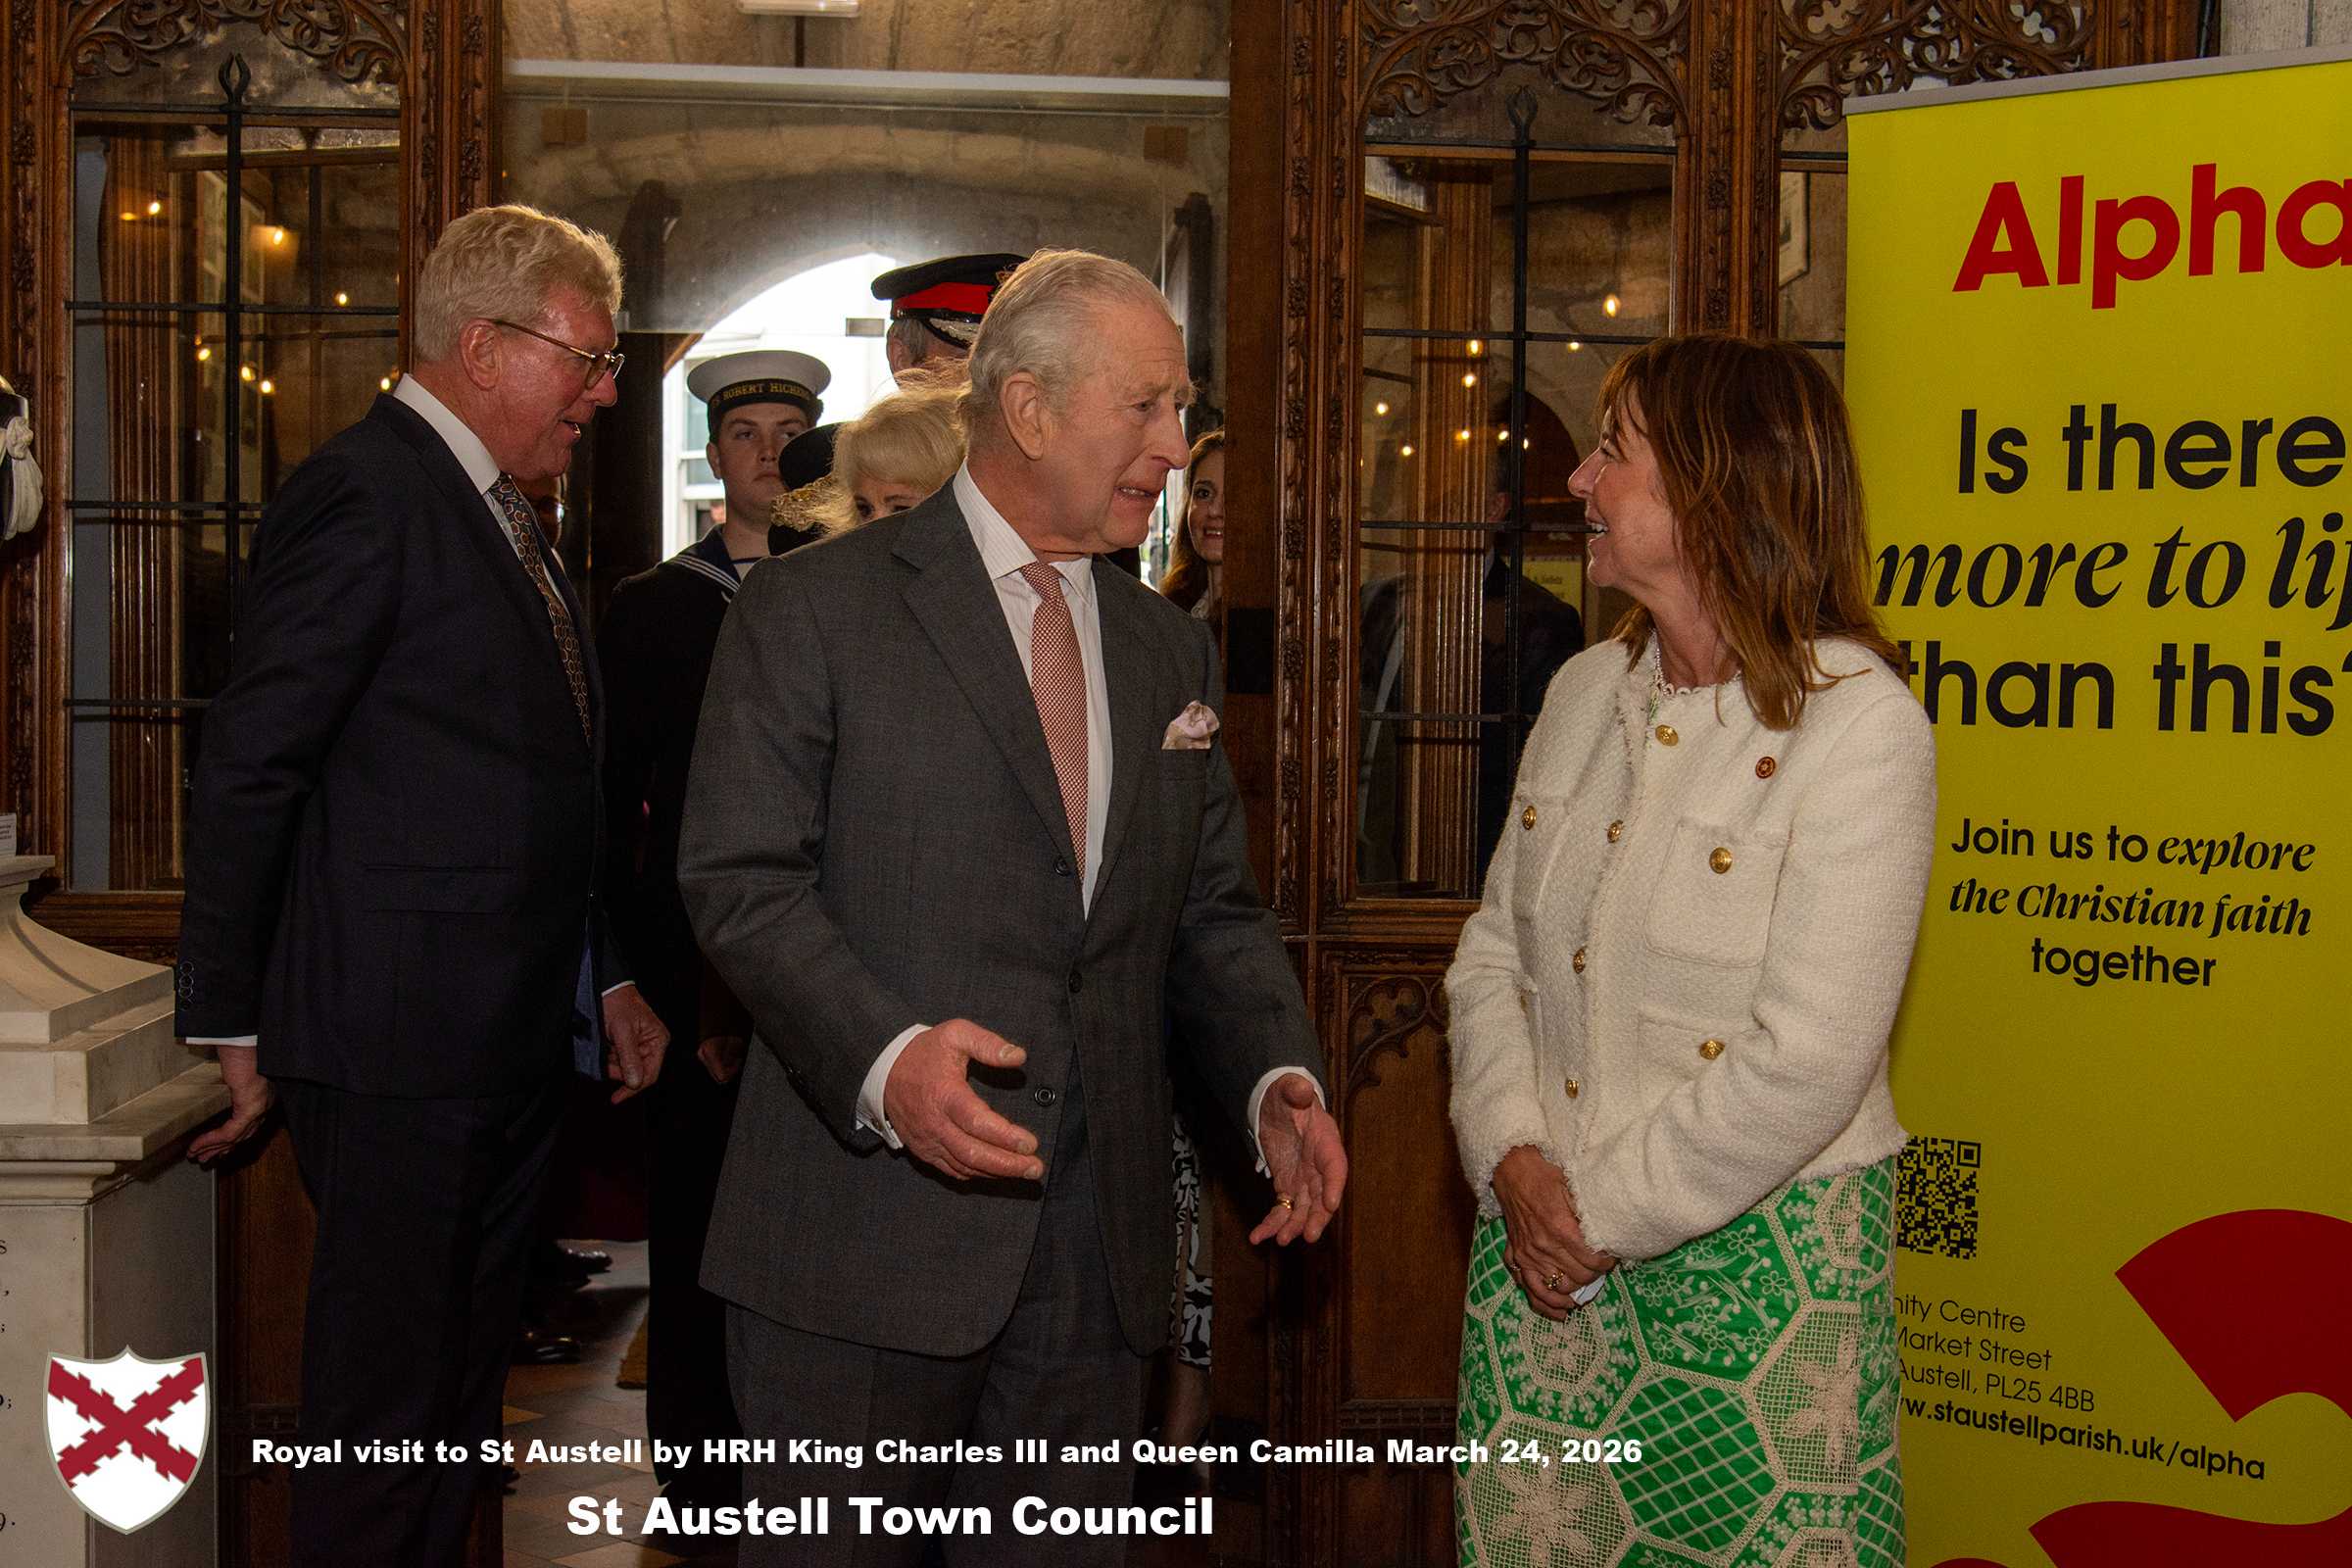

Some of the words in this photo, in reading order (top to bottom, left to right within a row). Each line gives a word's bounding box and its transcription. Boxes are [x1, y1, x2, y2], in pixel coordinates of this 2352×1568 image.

[1952, 163, 2352, 310] Alpha
[722, 382, 764, 400] ROBERT
[1958, 409, 2029, 495] Is
[2062, 403, 2346, 491] there
[1872, 542, 2129, 609] more
[2146, 525, 2246, 610] to
[2152, 640, 2352, 737] this
[1951, 817, 2034, 857] Join
[2049, 830, 2094, 860] us
[2106, 824, 2149, 863] to
[2157, 831, 2316, 875] explore
[1948, 877, 2011, 915] the
[2016, 882, 2205, 929] Christian
[2207, 893, 2312, 939] faith
[2031, 937, 2218, 988] together
[1938, 1299, 2027, 1334] Centre
[1979, 1338, 2053, 1372] Street
[1985, 1372, 2042, 1404] PL25
[2048, 1385, 2095, 1413] 4BB
[1898, 1396, 2266, 1481] w.staustellparish.uk/alpha
